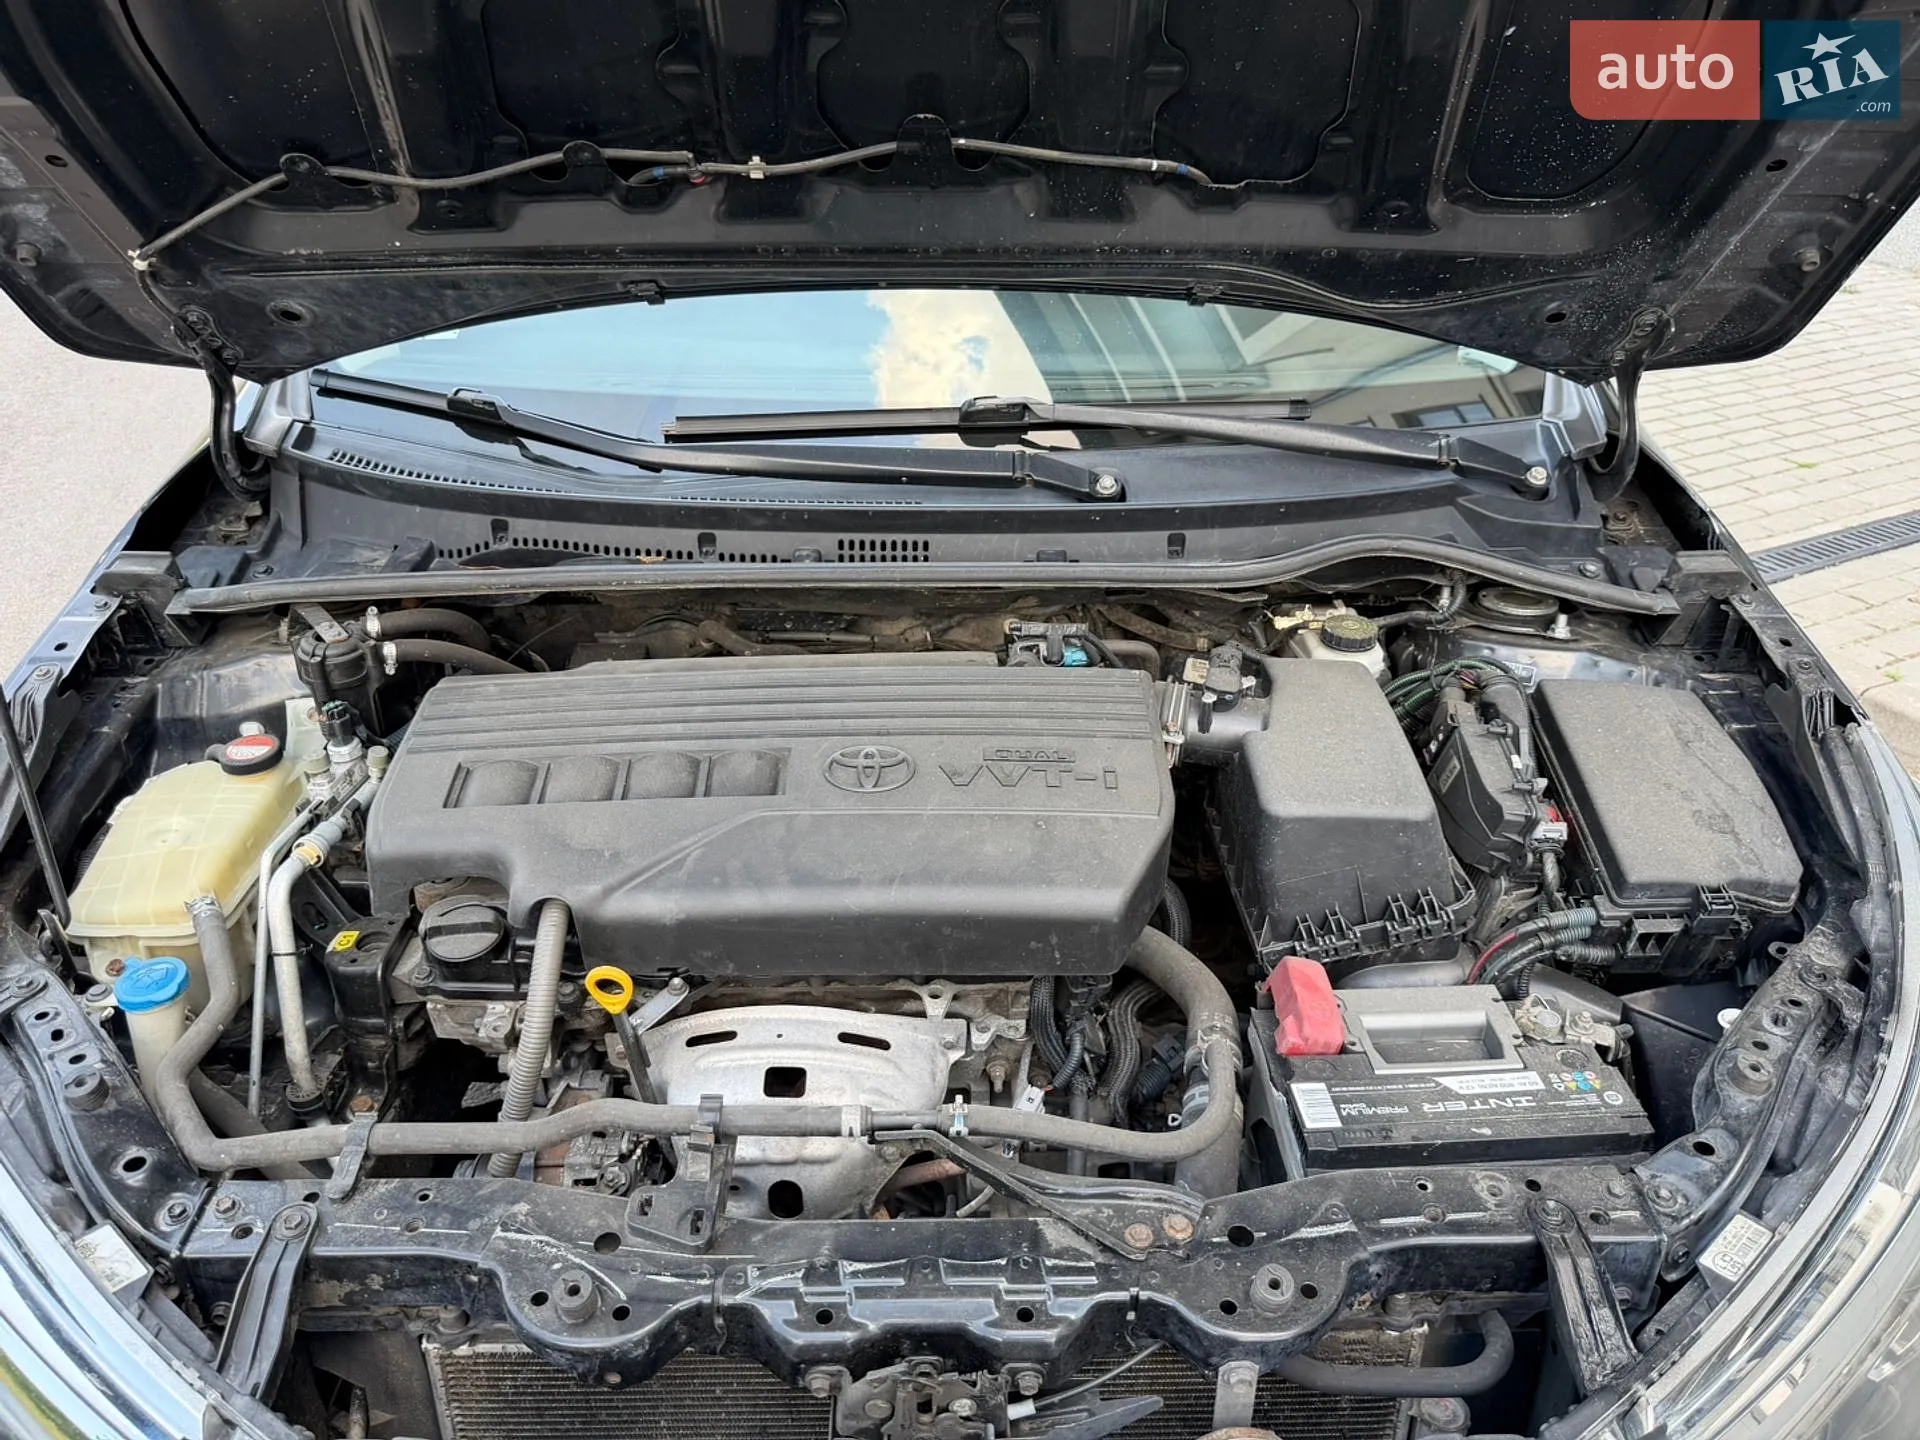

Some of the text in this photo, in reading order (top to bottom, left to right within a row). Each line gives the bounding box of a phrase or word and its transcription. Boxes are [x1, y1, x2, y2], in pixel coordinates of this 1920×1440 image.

[994, 749, 1068, 760] DUAL
[1421, 1096, 1537, 1112] INTER
[1340, 1106, 1409, 1116] PREMIUM
